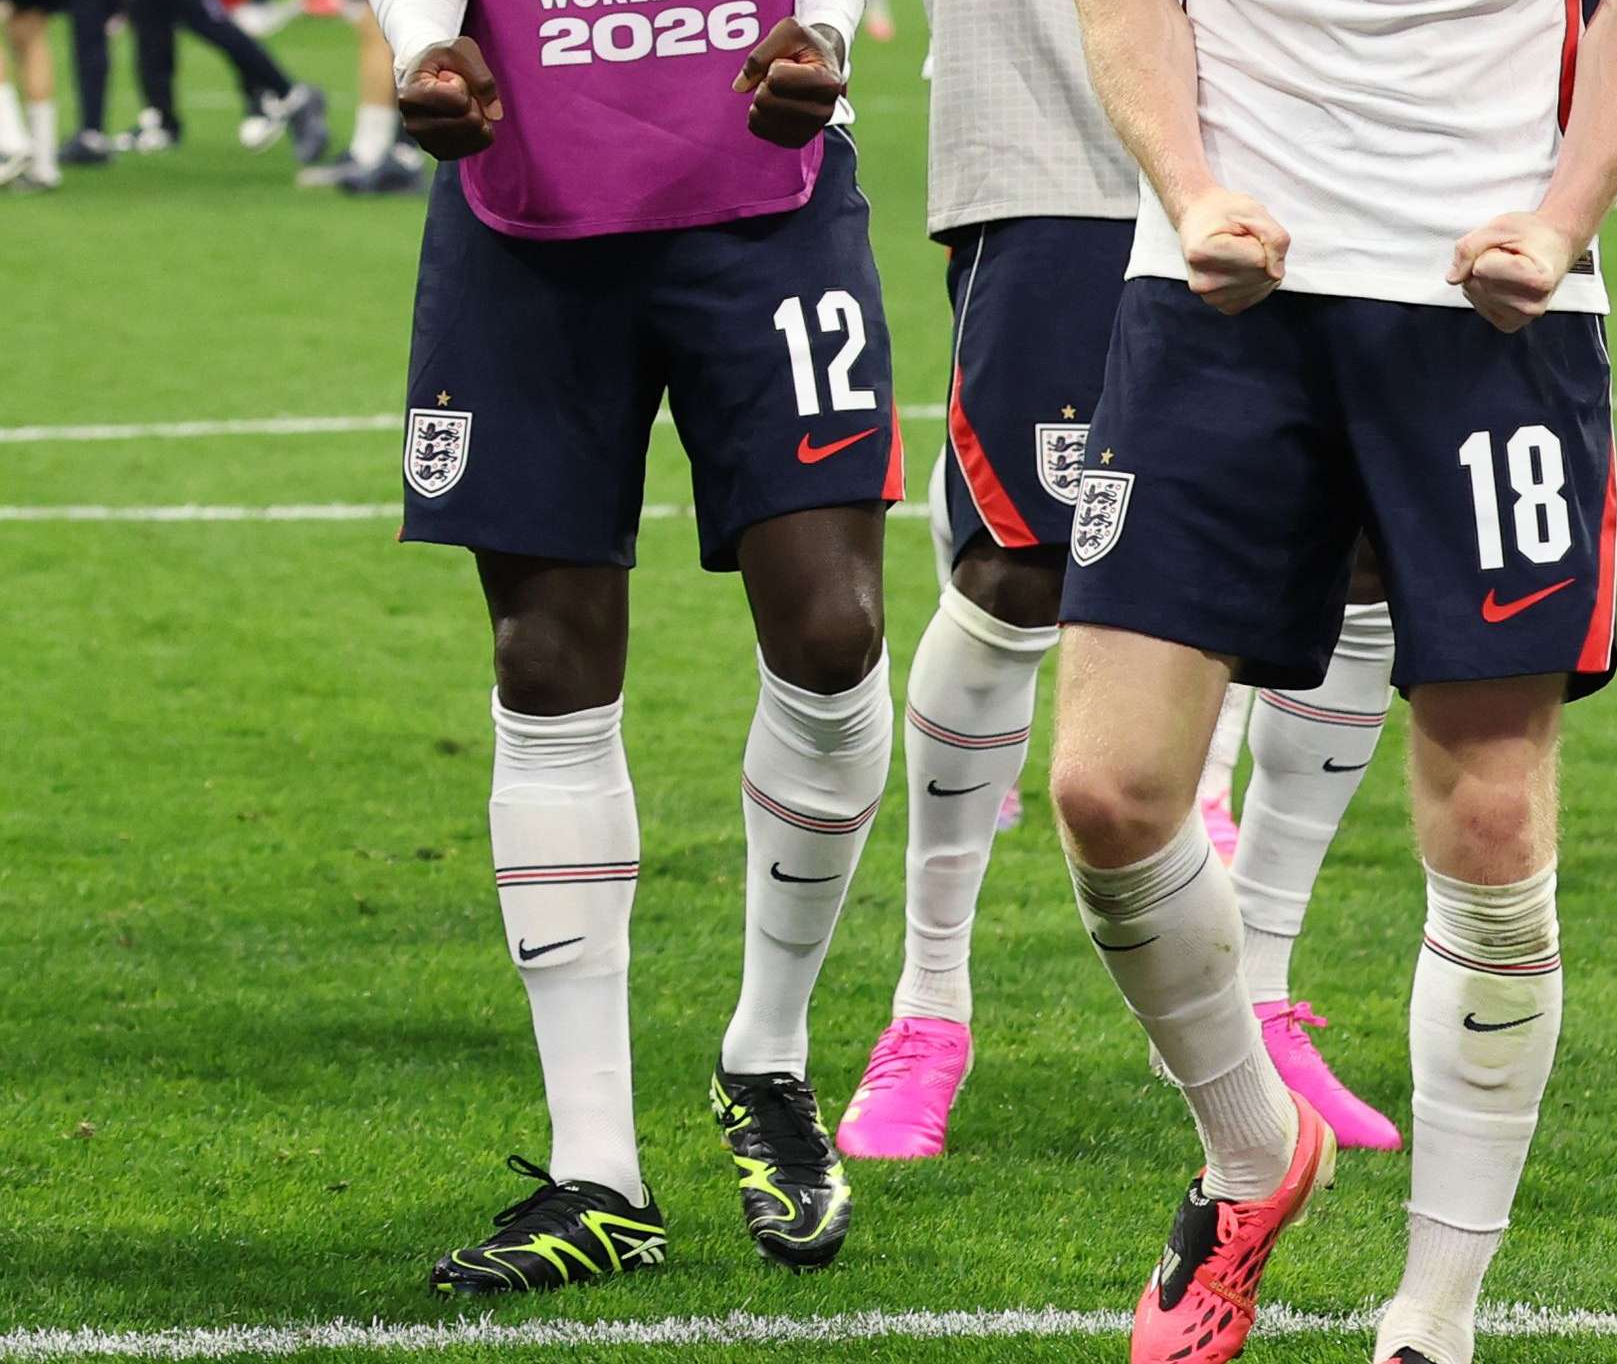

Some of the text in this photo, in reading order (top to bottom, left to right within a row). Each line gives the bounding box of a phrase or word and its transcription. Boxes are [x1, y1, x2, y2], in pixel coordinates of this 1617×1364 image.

[538, 0, 761, 68] 2026
[773, 290, 877, 416] 12
[1458, 424, 1572, 570] 18
